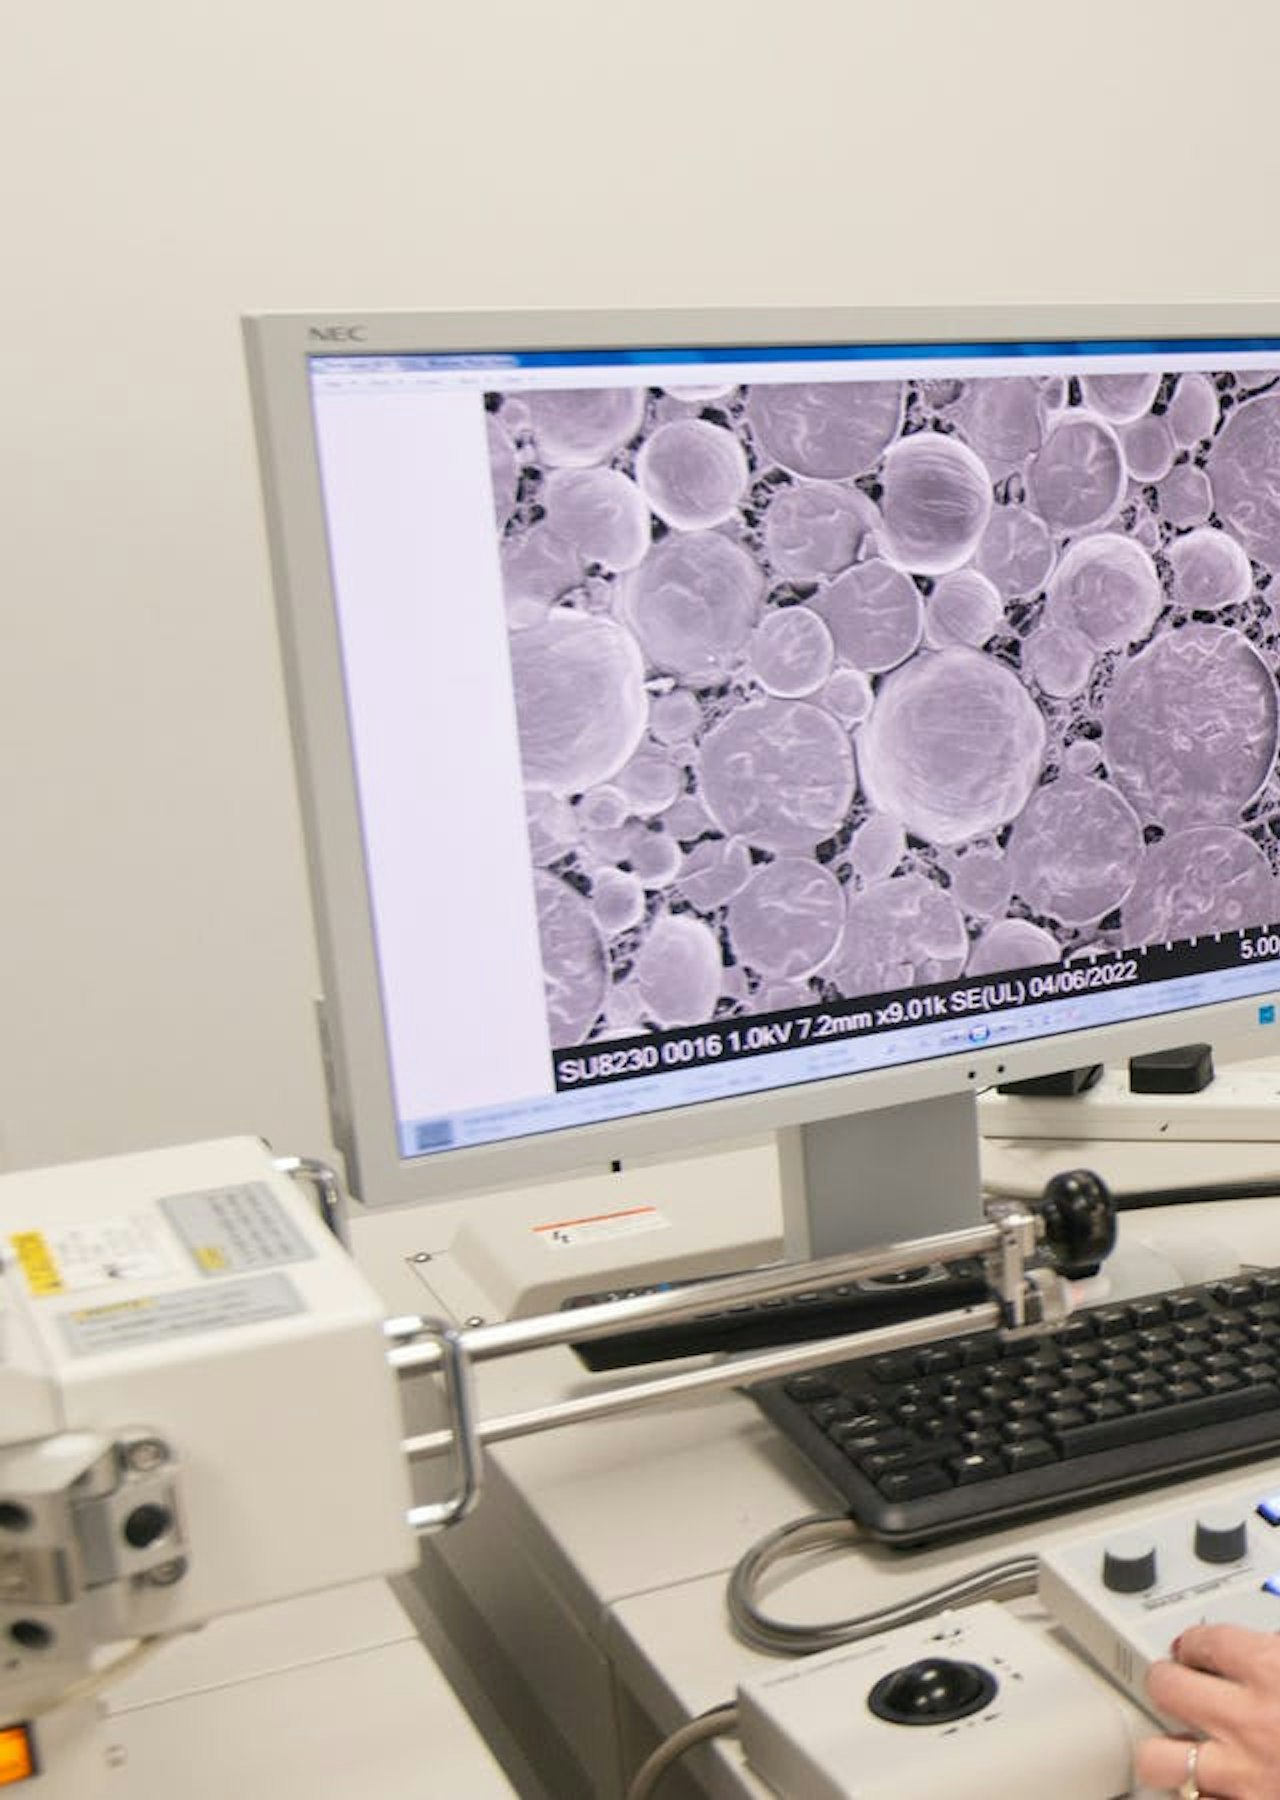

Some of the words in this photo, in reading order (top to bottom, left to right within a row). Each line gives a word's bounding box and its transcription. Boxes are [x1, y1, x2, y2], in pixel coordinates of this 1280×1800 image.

[309, 325, 368, 341] NEC
[559, 1046, 659, 1083] SU8230
[663, 1035, 722, 1064] 0016
[729, 1021, 793, 1052] 1.0kV
[799, 1011, 873, 1041] 7.2mm
[877, 994, 947, 1027] x9.01k
[951, 979, 1026, 1012] SE(UL)
[1029, 960, 1138, 998] 04/06/2022
